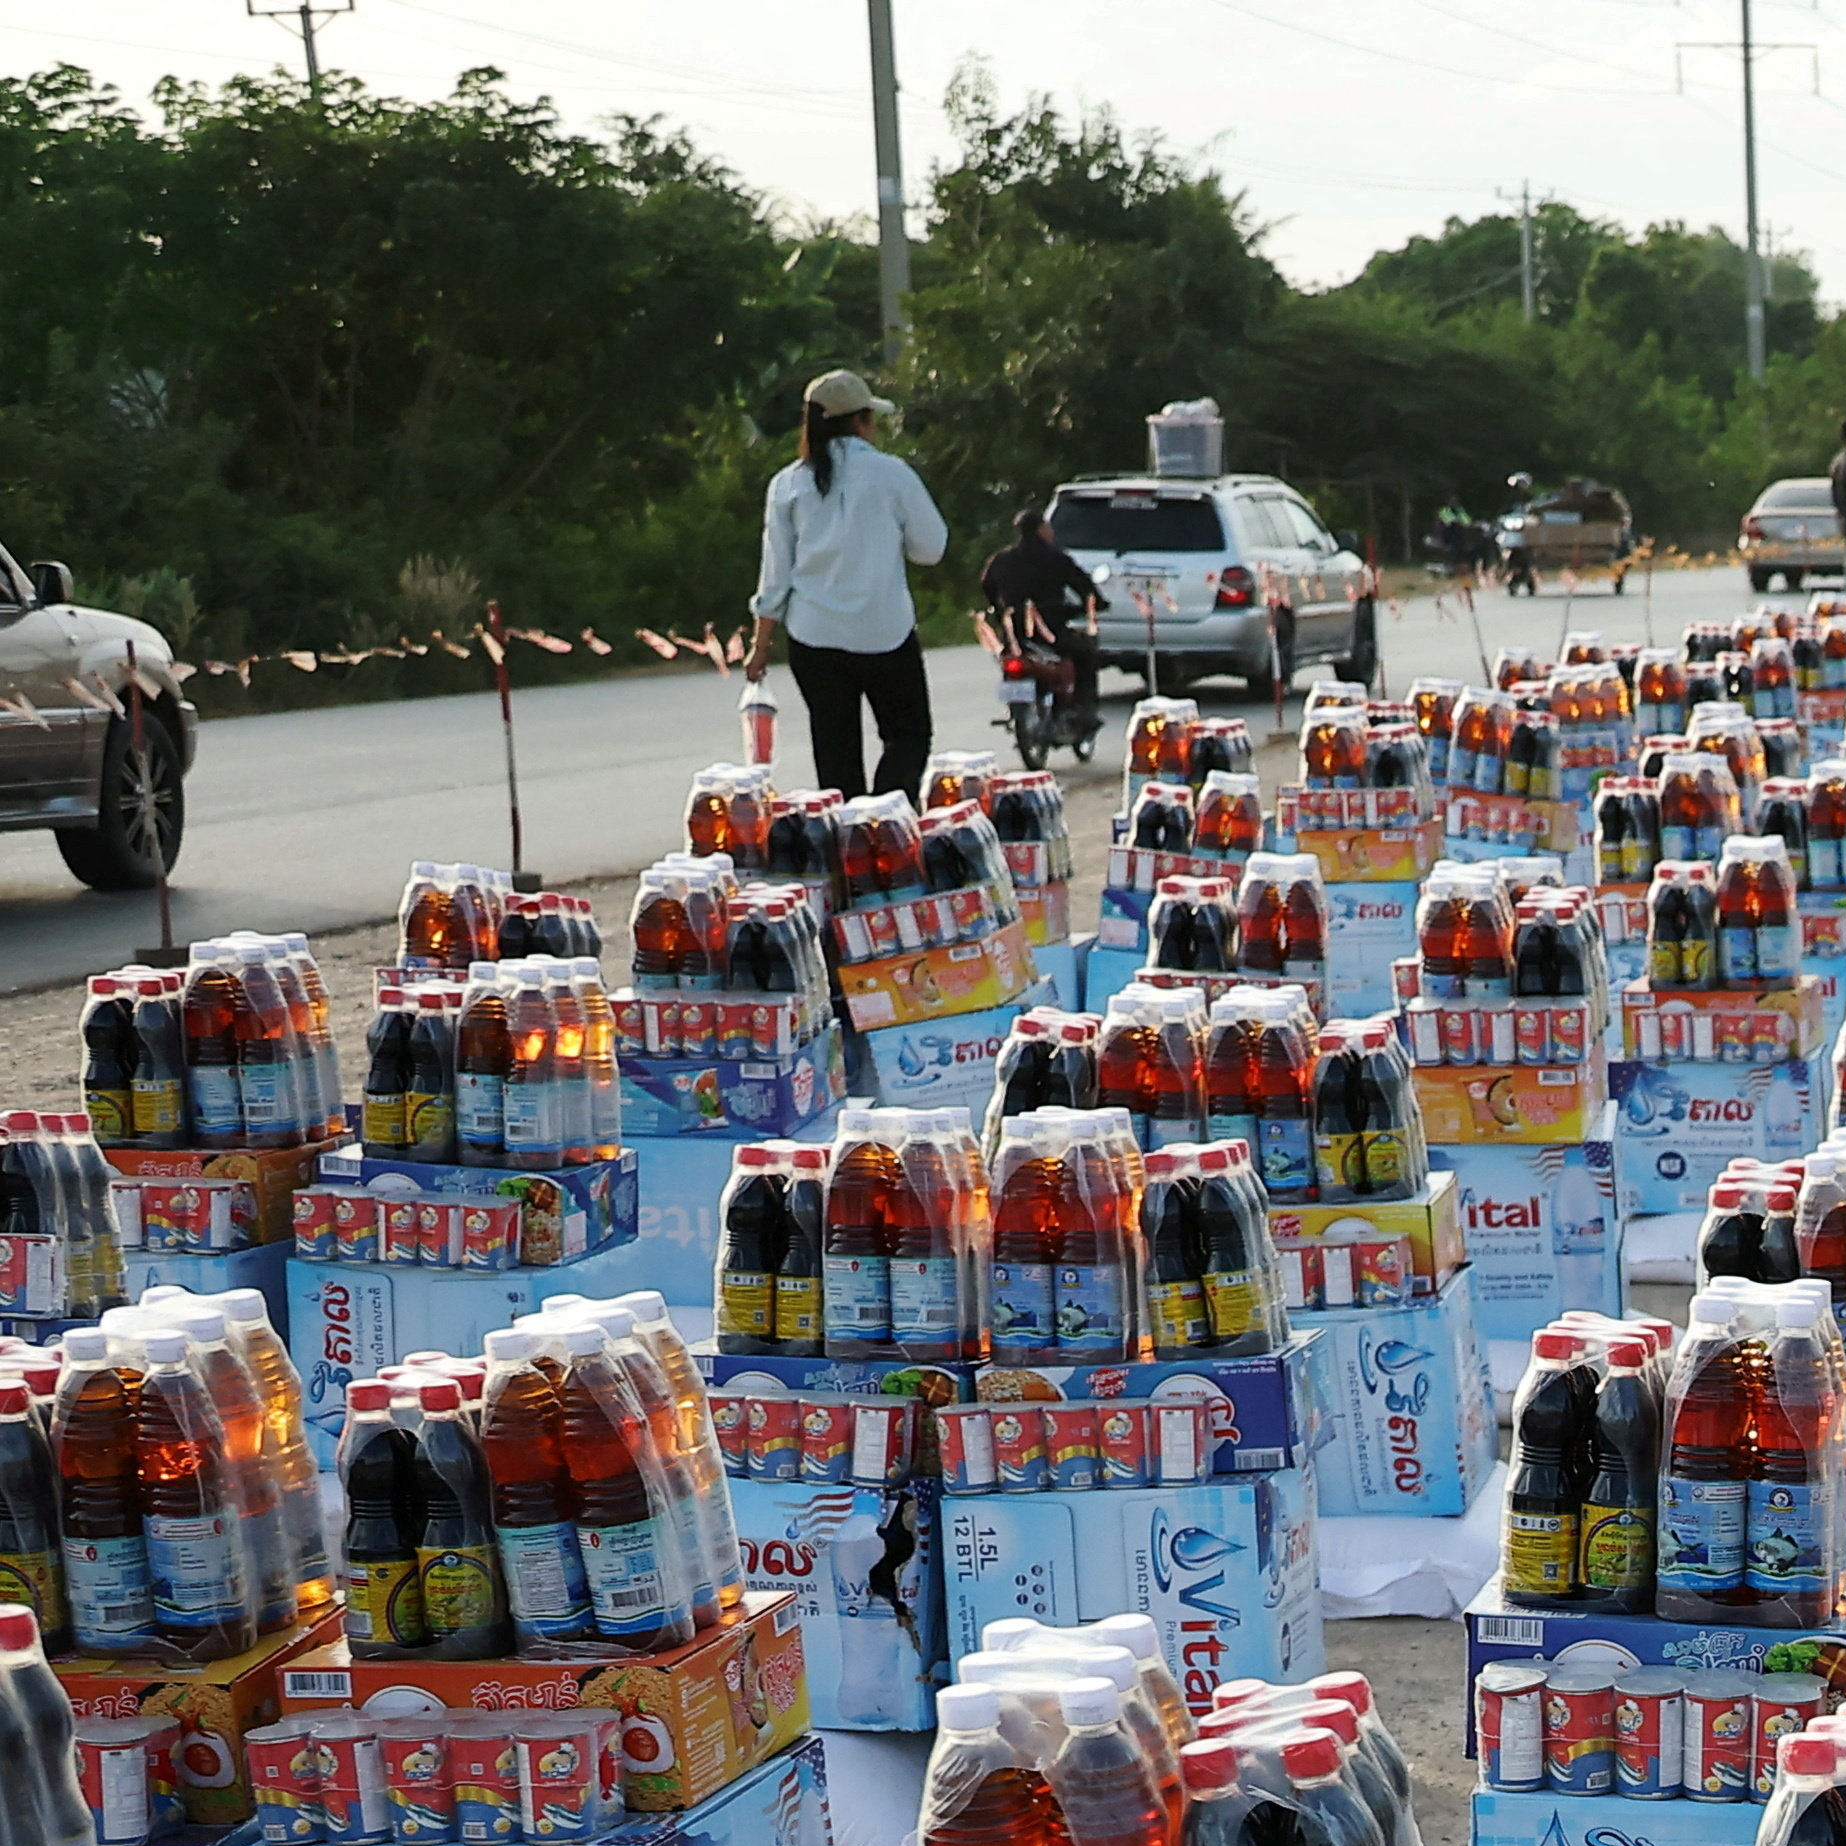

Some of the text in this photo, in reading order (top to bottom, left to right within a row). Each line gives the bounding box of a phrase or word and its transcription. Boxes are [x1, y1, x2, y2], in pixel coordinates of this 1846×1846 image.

[1462, 1191, 1541, 1229] ital
[953, 1516, 973, 1583] 12 BTL
[979, 1527, 997, 1571] 1.5L
